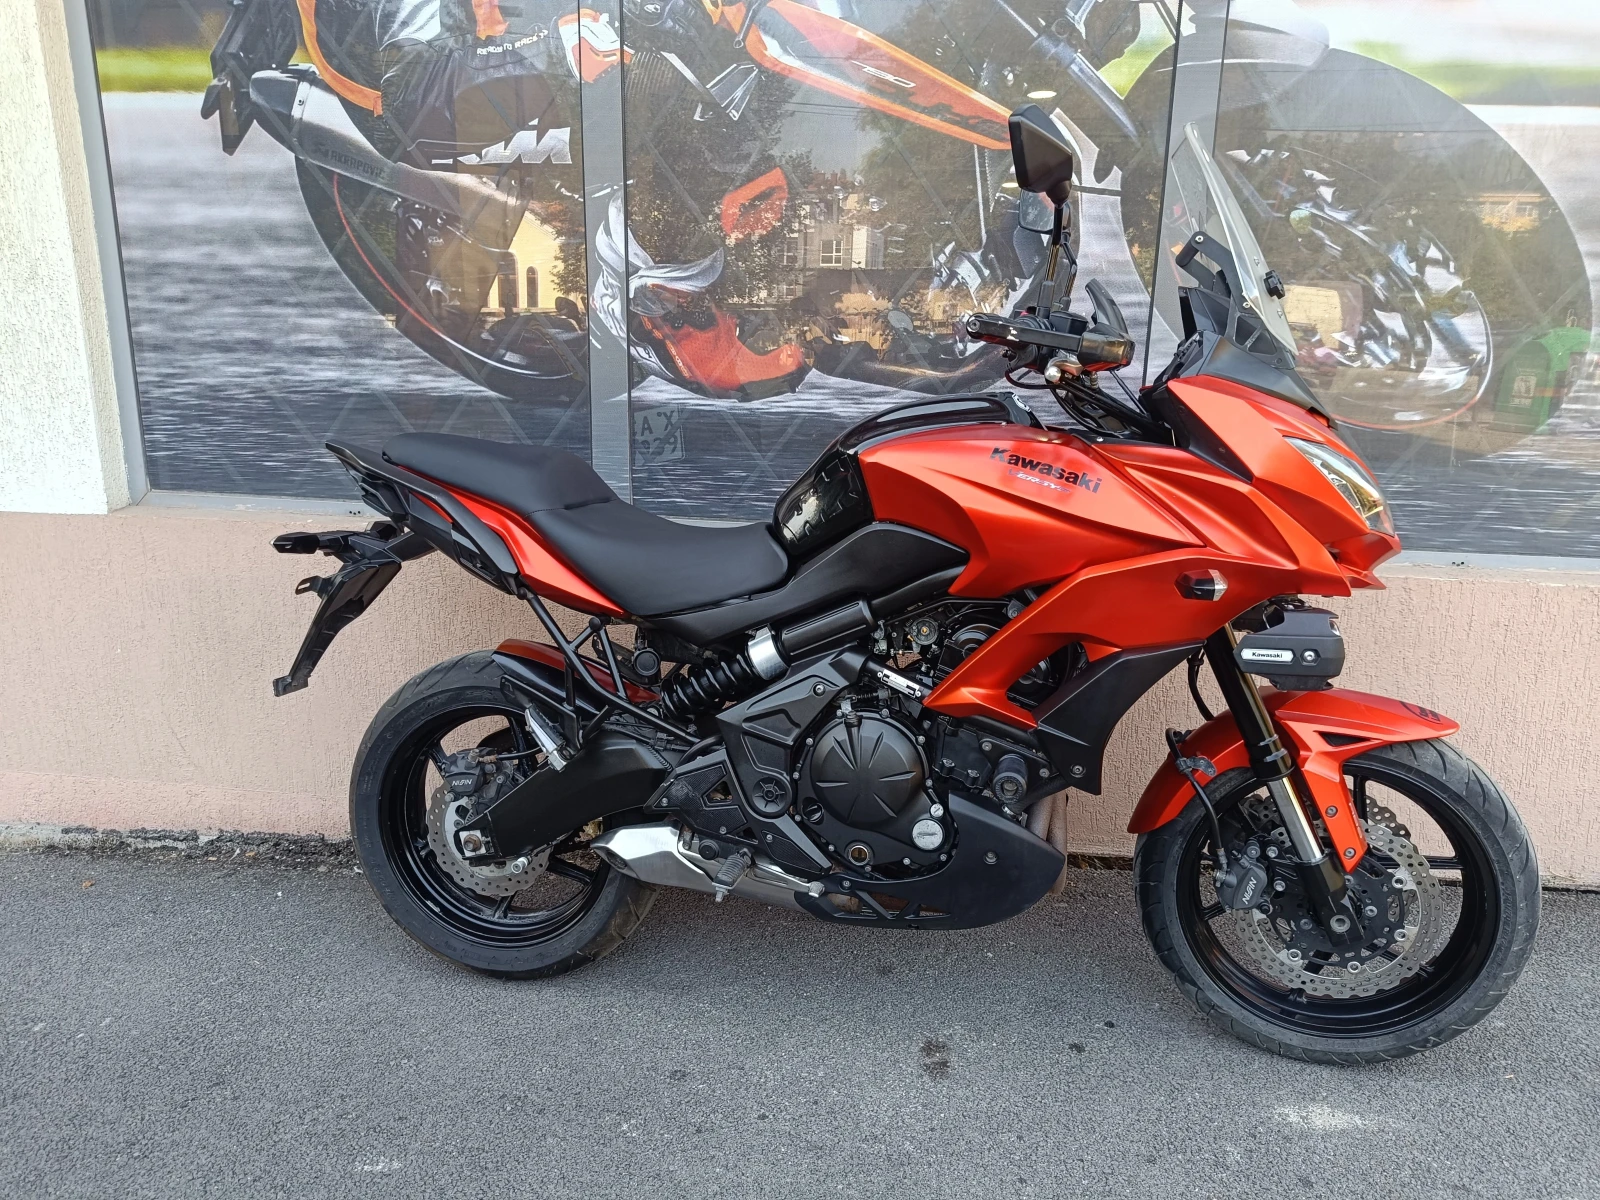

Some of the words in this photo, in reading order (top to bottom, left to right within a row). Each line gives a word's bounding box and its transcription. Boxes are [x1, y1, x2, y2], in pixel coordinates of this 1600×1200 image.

[514, 34, 538, 49] RACE
[989, 446, 1102, 494] Kawasaki
[1251, 651, 1283, 659] Kawasaki
[1242, 876, 1257, 905] NISSIN
